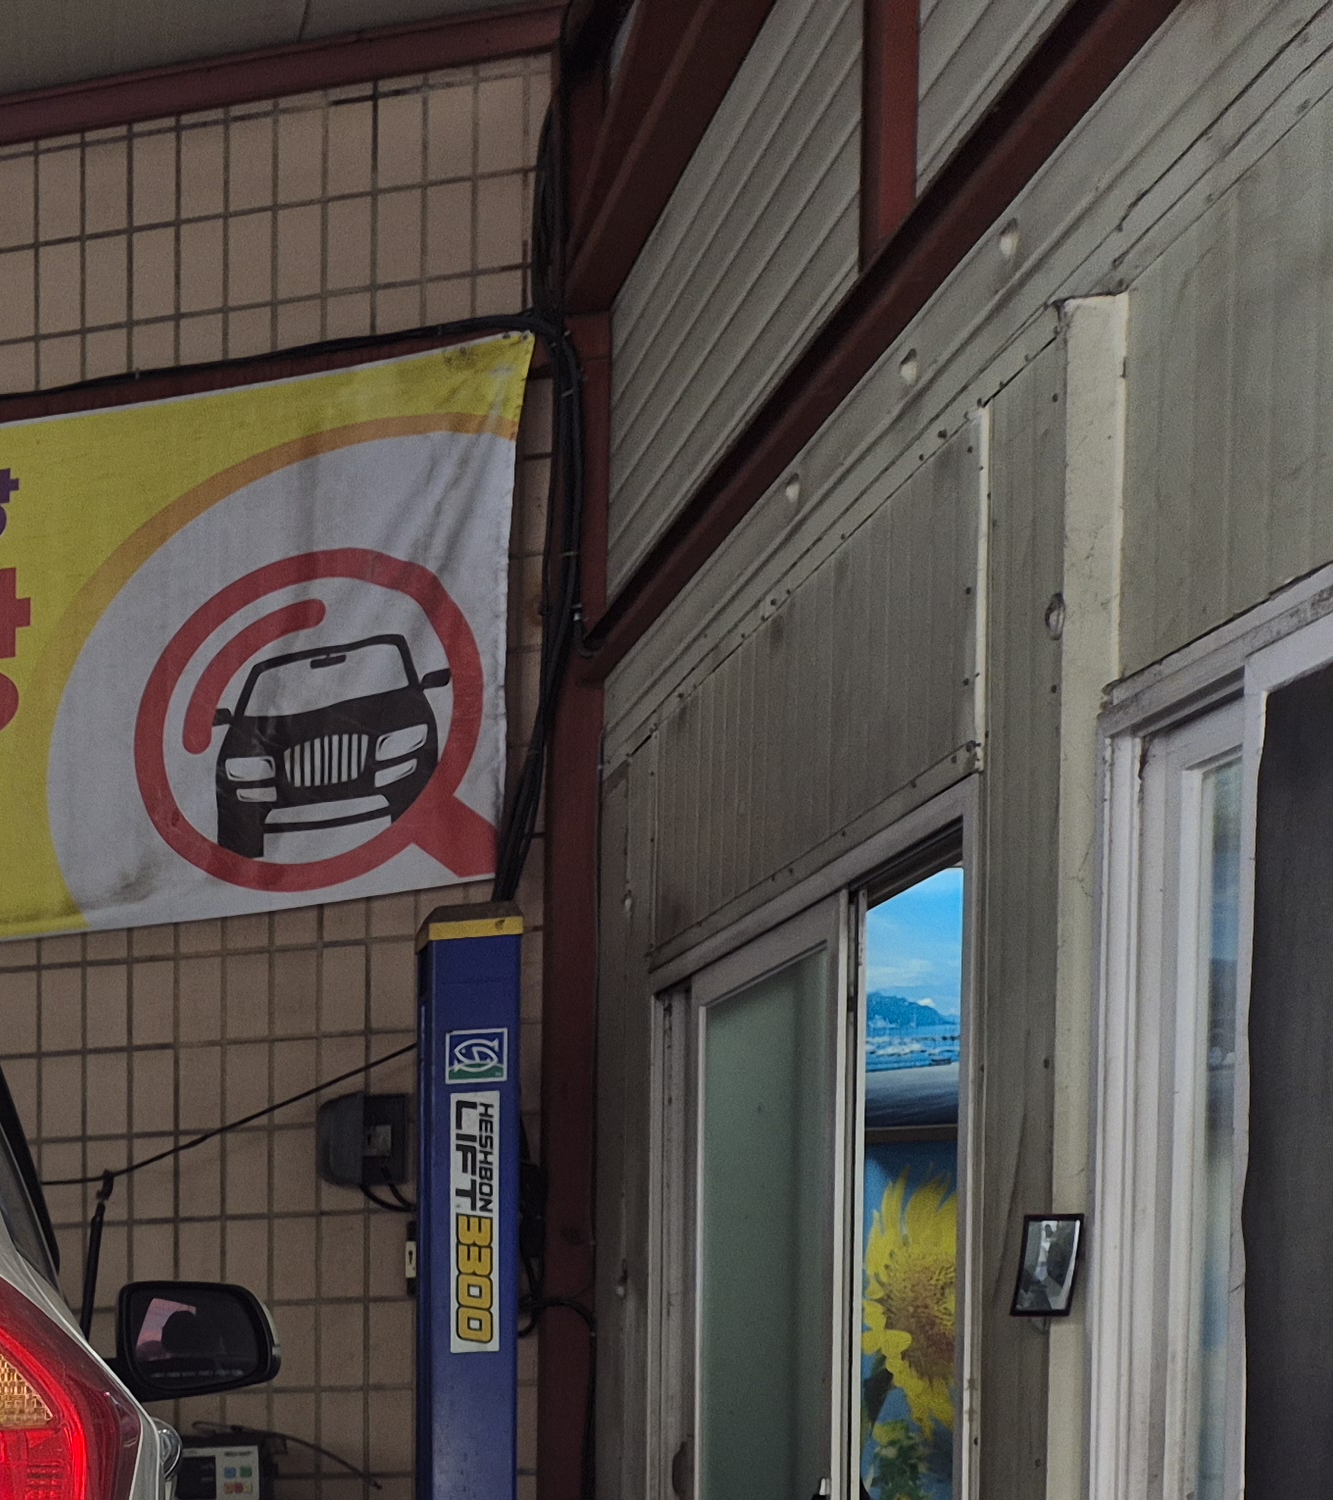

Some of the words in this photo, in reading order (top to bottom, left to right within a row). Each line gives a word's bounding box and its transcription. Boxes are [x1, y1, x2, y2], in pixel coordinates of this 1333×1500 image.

[455, 1100, 477, 1211] LIFT
[478, 1102, 494, 1213] HESHBON
[456, 1214, 493, 1343] 3300
